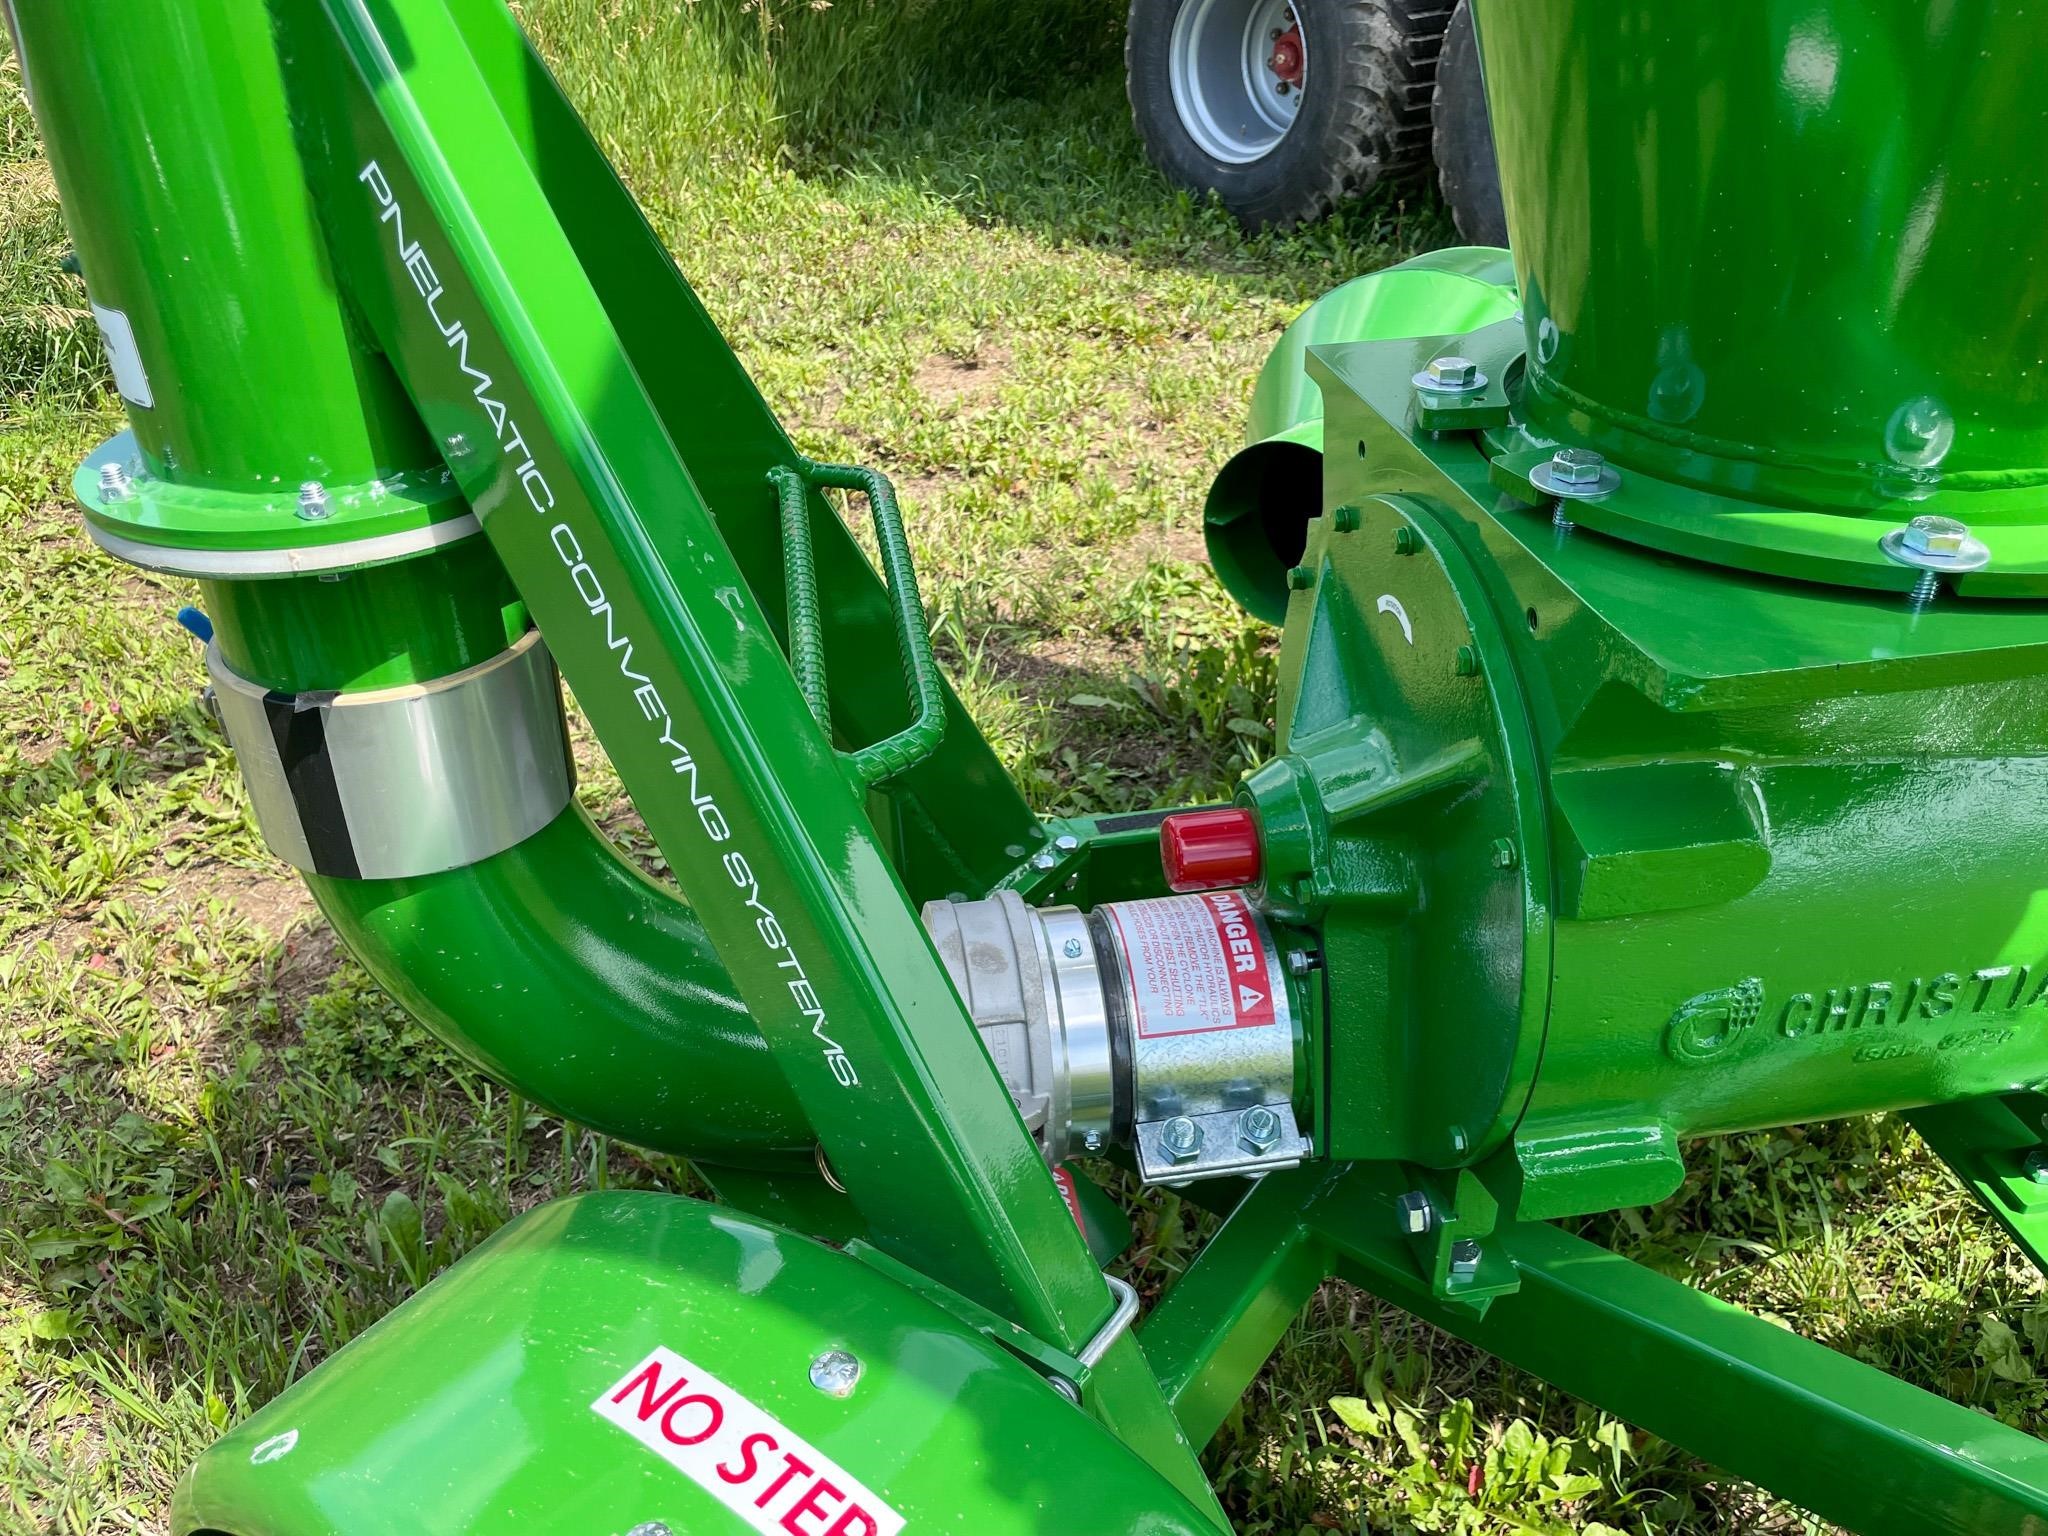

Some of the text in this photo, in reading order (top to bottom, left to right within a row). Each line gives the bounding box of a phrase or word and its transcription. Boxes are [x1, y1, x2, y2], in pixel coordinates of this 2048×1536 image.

[359, 160, 860, 1089] PNEUMATIC CONVEYING SYSTEMS
[1140, 940, 1153, 965] FROM
[1162, 942, 1177, 966] FIRST
[1175, 942, 1187, 957] THE
[1206, 927, 1222, 964] MACHINE
[1209, 894, 1257, 973] DANGER
[1146, 966, 1159, 993] YOUR
[1151, 941, 1174, 1016] DISCONNECTING
[1179, 959, 1195, 1005] CYCLONE
[1183, 935, 1201, 971] REMOVE
[1195, 973, 1206, 993] THE
[1192, 924, 1210, 960] TRACTOR
[1202, 962, 1221, 1024] HYDRAULICS
[1214, 966, 1225, 975] IS
[1169, 968, 1185, 1017] SHUTTING
[1217, 976, 1232, 1016] ALWAYS
[611, 1361, 878, 1536] NO STEP
